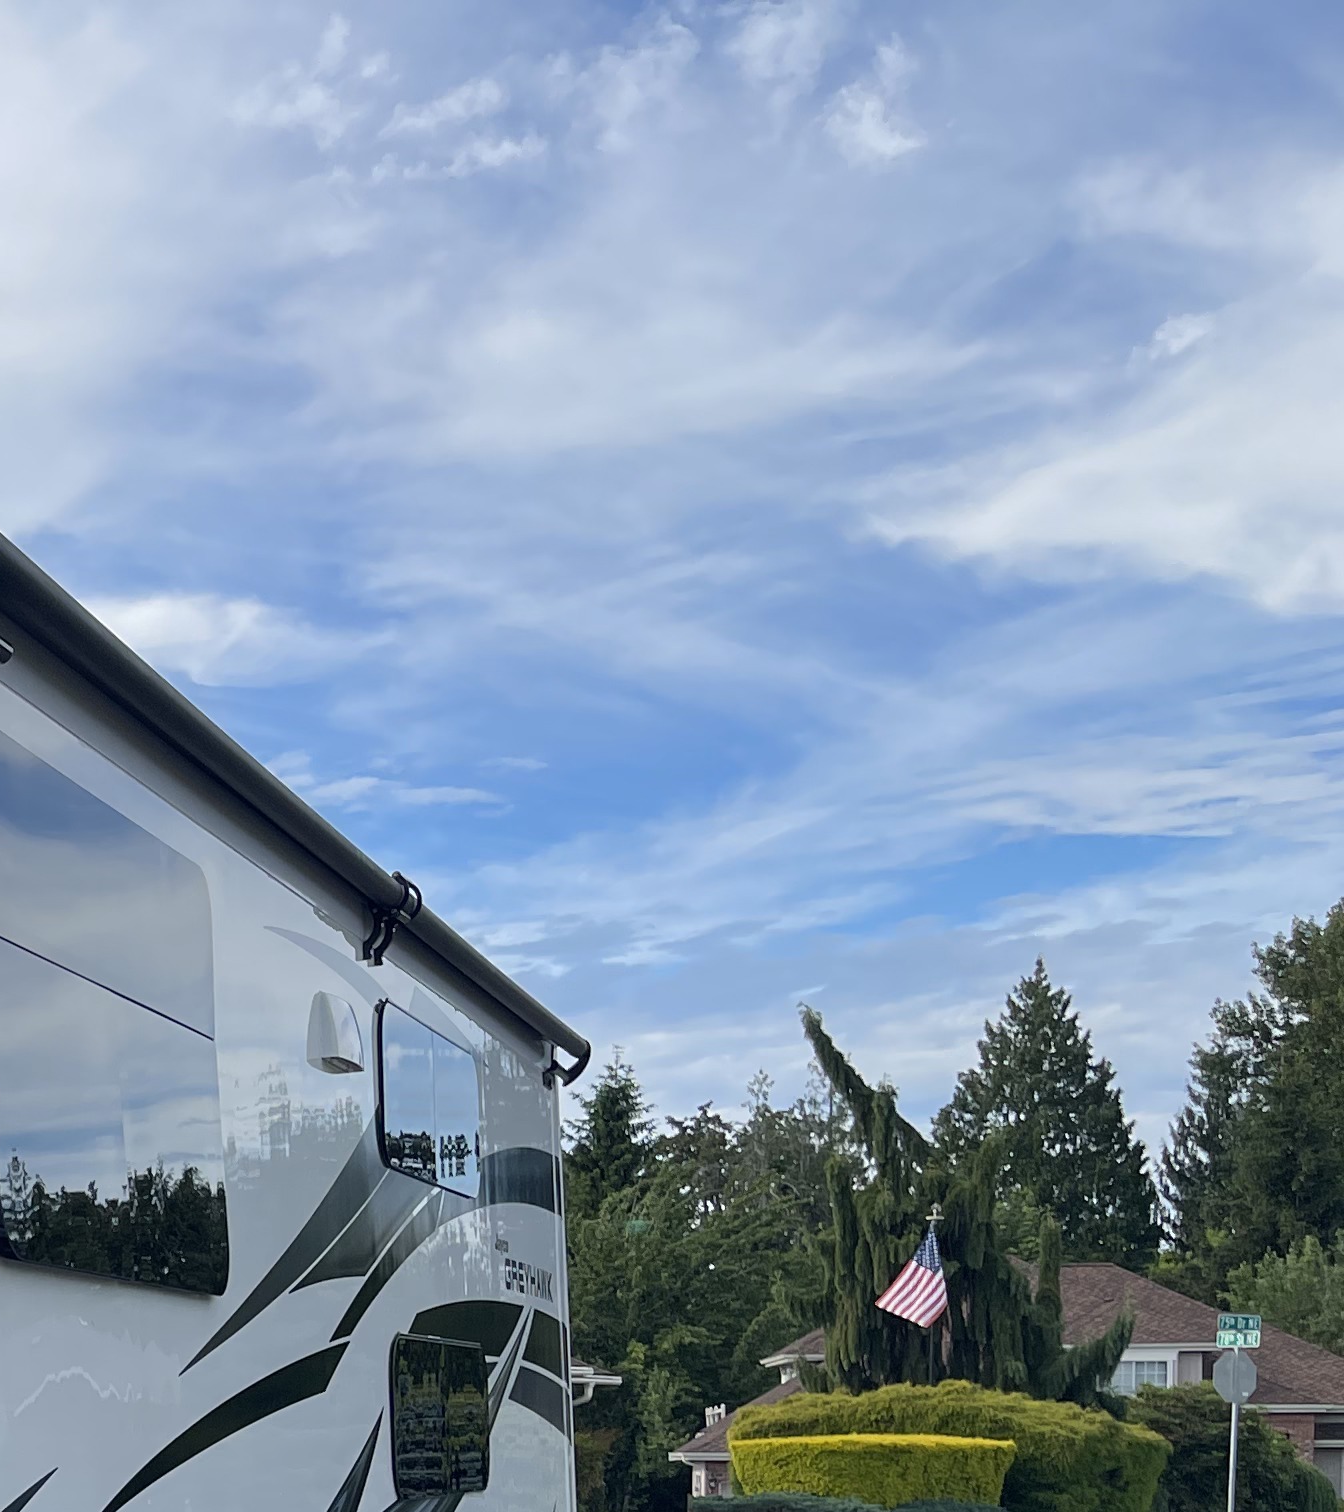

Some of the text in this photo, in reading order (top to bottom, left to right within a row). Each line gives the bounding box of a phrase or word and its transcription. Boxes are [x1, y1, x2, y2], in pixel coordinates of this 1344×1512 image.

[505, 1258, 554, 1303] GREYHAWK
[1248, 1317, 1259, 1330] NE
[1246, 1333, 1257, 1346] NE
